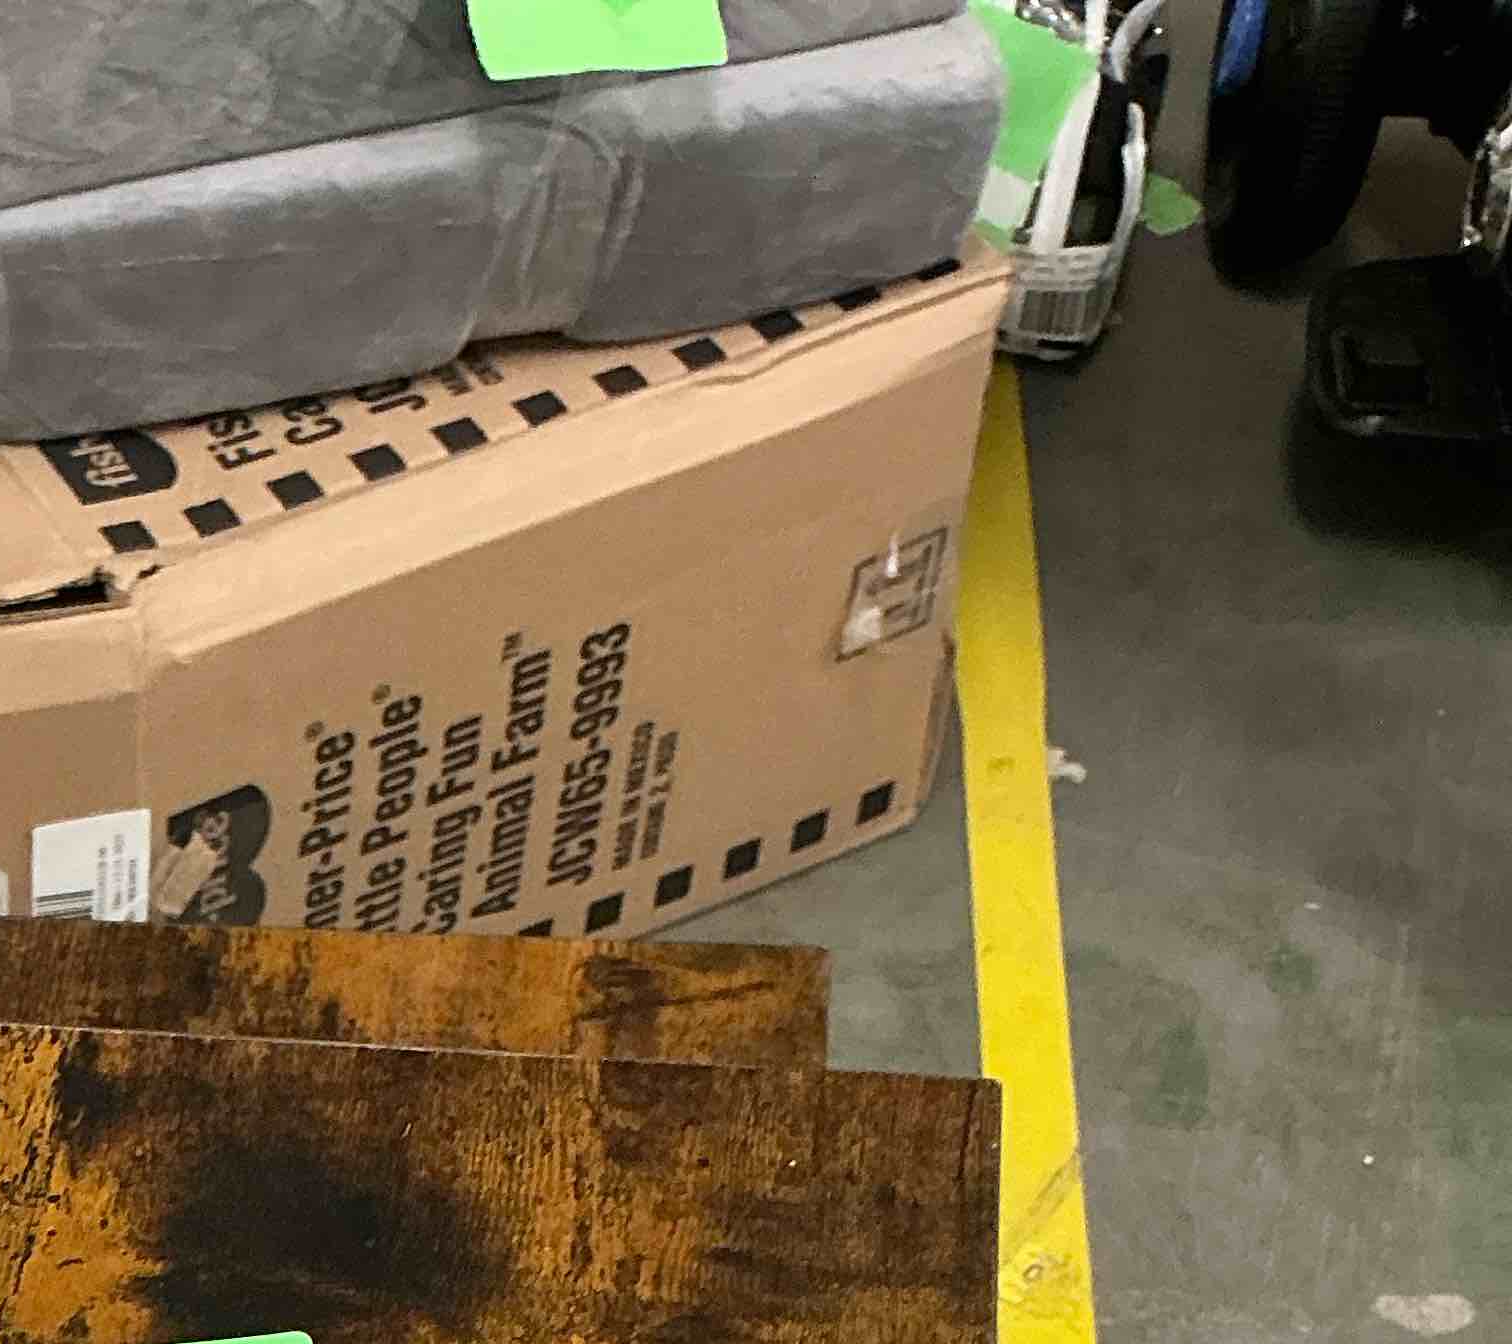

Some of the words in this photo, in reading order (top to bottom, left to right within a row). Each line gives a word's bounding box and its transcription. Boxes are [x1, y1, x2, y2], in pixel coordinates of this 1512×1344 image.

[426, 713, 482, 806] Fun
[546, 622, 631, 887] JCW65-9993
[469, 773, 536, 918] Animal
